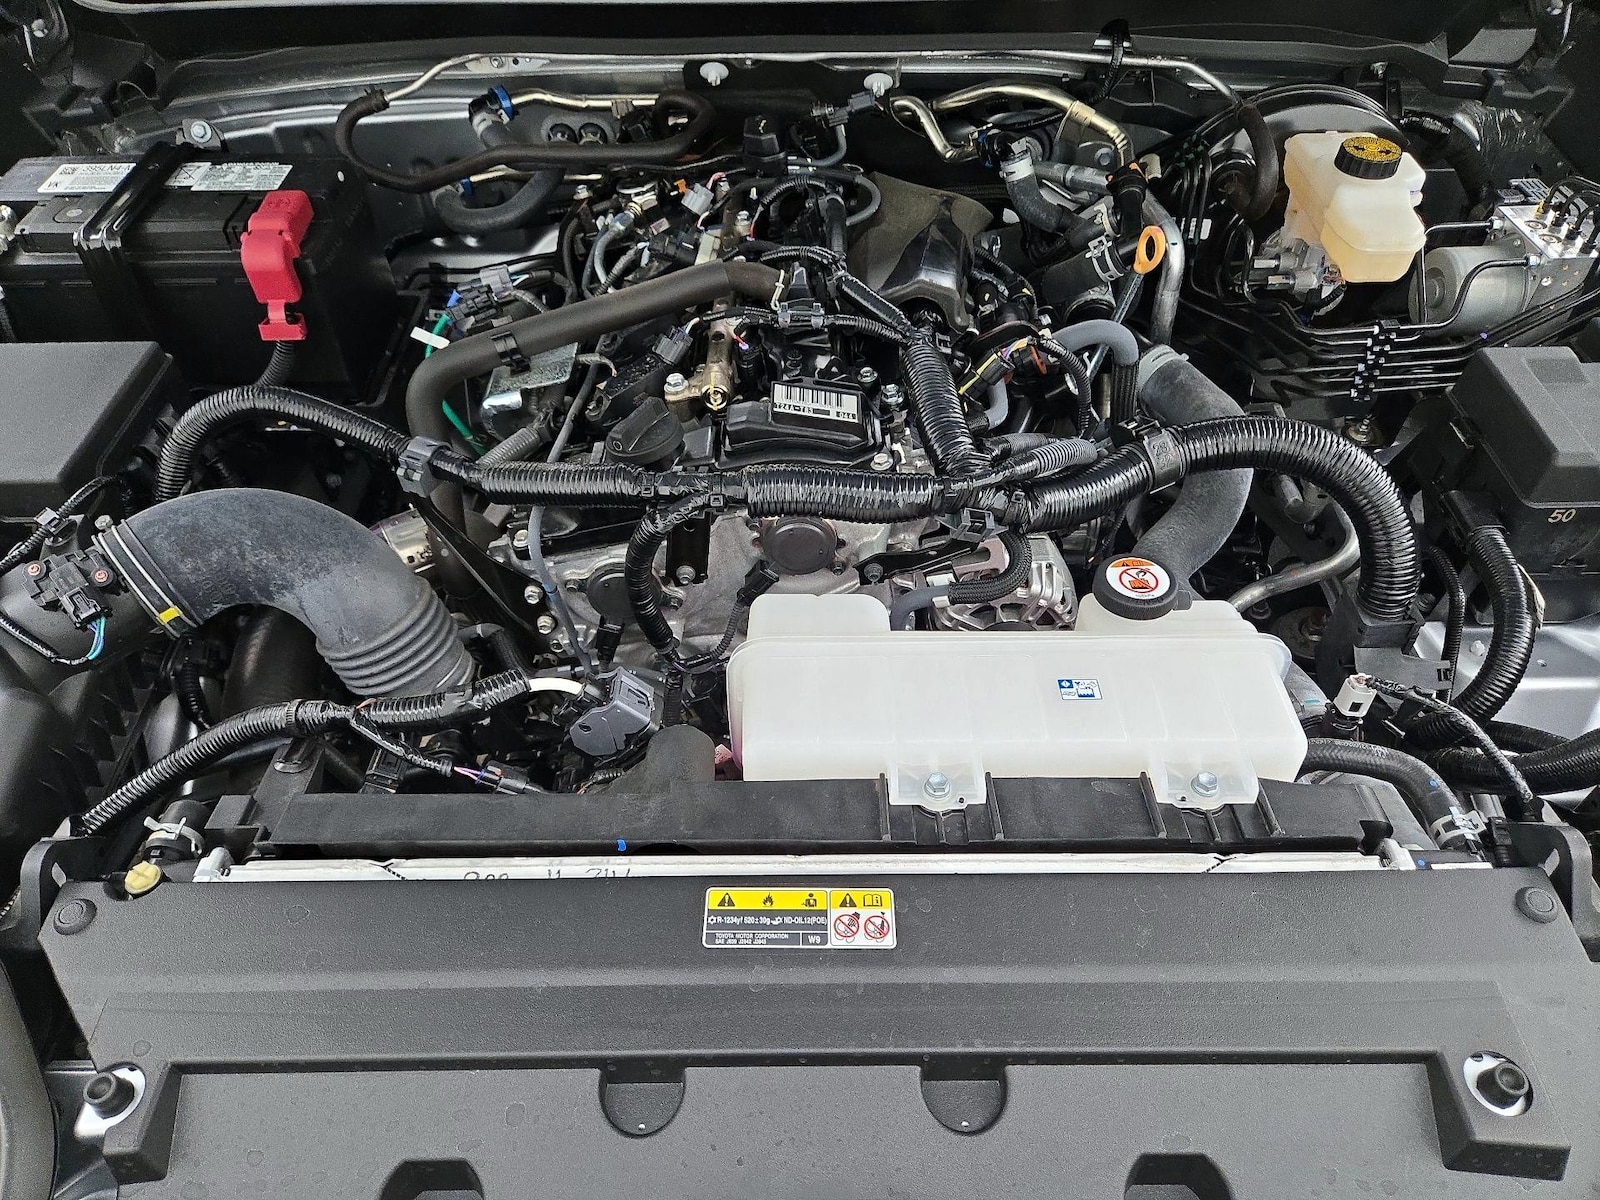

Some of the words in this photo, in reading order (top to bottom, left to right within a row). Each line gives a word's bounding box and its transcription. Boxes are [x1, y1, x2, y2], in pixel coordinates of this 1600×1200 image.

[1548, 509, 1576, 523] 50
[717, 916, 743, 925] R-1234yf
[783, 916, 827, 926] ND-OIL12(POE)
[808, 935, 821, 944] W9
